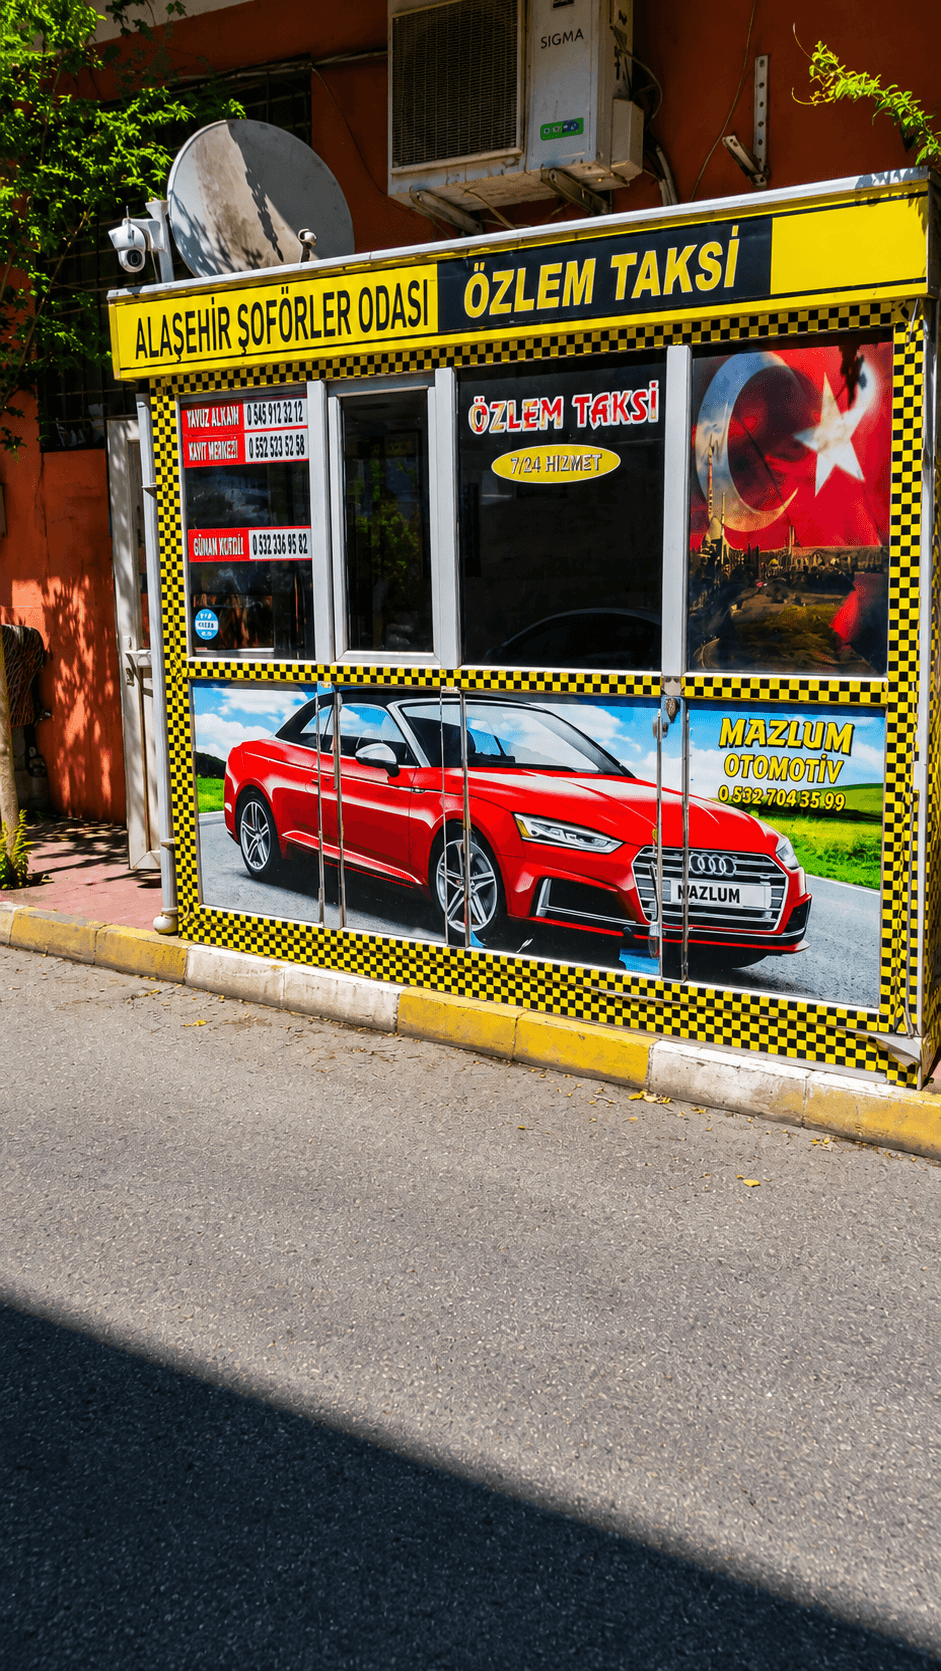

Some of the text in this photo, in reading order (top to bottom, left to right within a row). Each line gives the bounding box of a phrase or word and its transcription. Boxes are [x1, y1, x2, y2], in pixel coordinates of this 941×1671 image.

[541, 28, 584, 49] SIGMA
[463, 225, 739, 318] ÖZLEM TAKSİ
[135, 278, 429, 362] ALAŞEHİR ŞOFÖRLER ODASI
[468, 380, 659, 435] ÖZLEM TAKSİ
[510, 456, 541, 475] 7/24
[718, 717, 855, 756] MAZLUM
[724, 753, 844, 784] OTOMOTİV
[732, 785, 763, 805] 532
[824, 791, 846, 812] 99
[678, 884, 740, 903] MAZLUM
